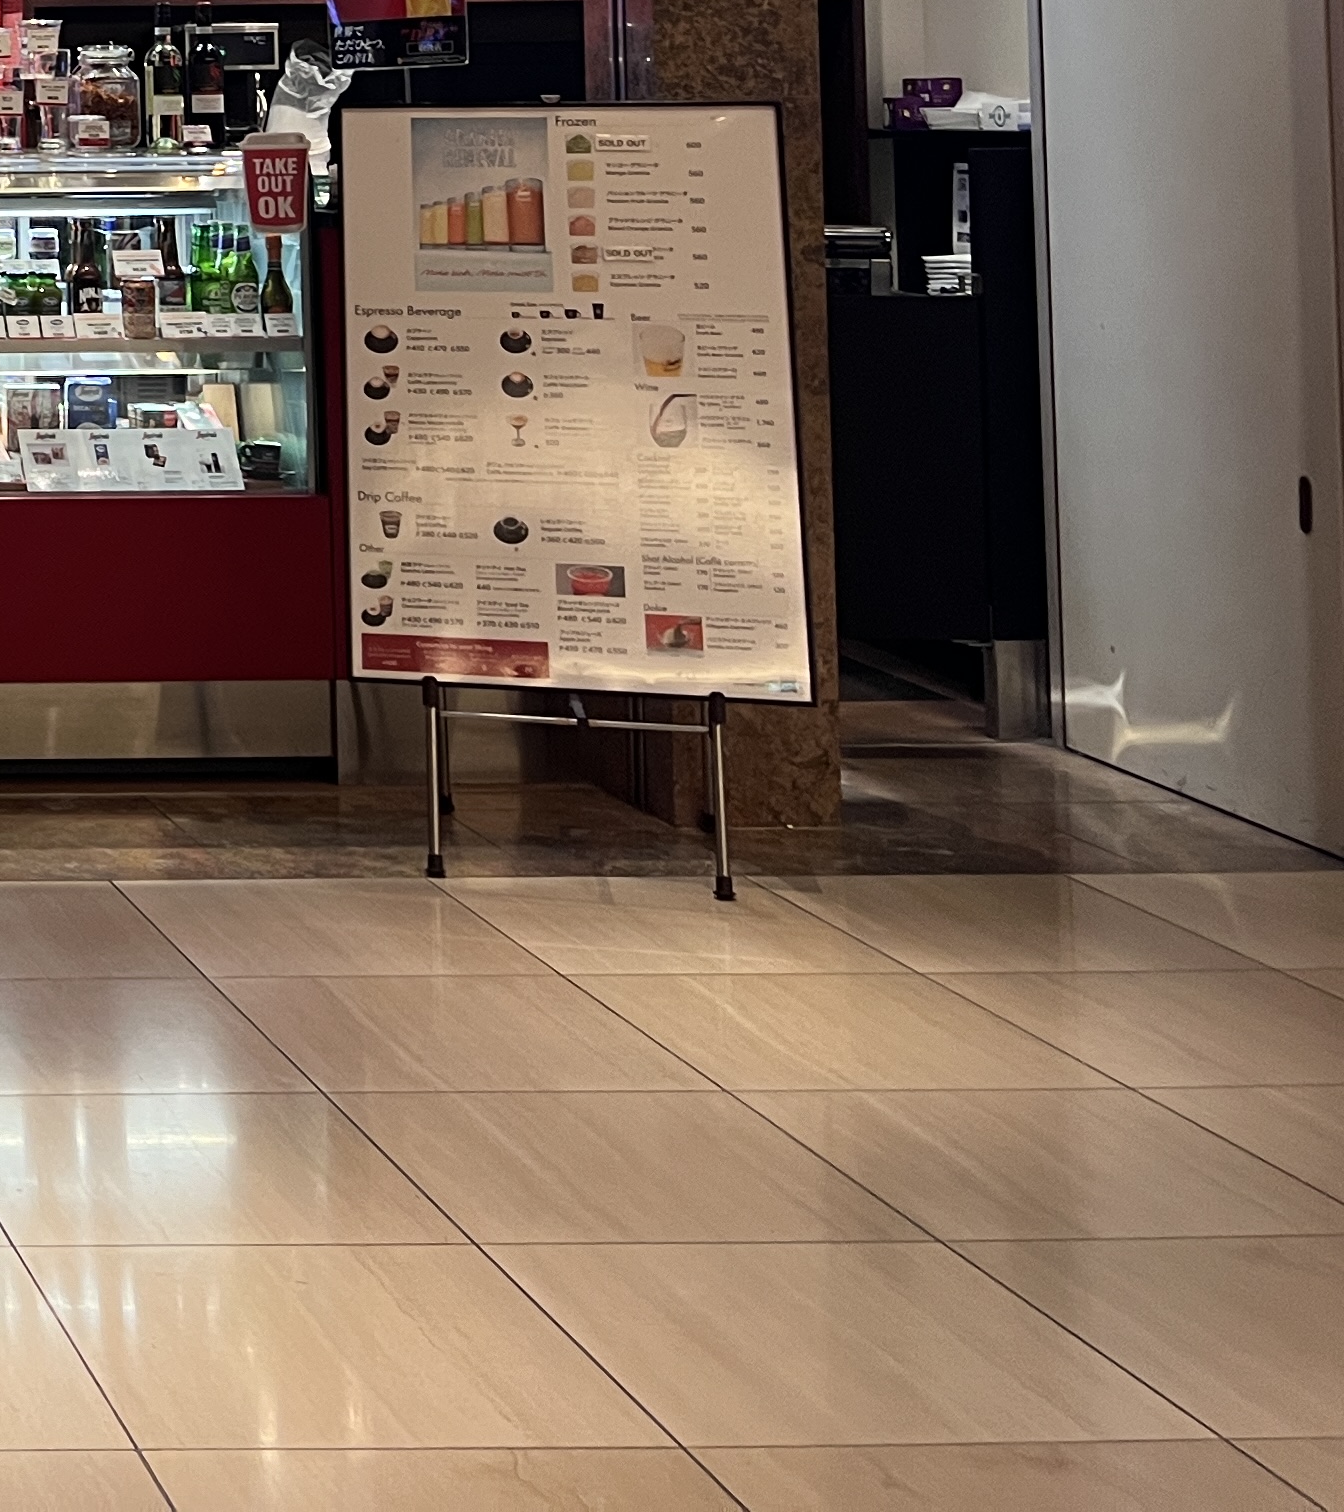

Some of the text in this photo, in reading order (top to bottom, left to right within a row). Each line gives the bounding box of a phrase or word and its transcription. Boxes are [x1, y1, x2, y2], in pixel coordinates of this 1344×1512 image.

[555, 116, 597, 127] Frozen
[598, 140, 646, 148] SOLD OUT
[252, 157, 298, 175] TAKE
[257, 175, 294, 193] OUT
[258, 196, 296, 219] OK
[605, 249, 653, 258] SOLD OUT
[354, 304, 462, 318] Espresso Beverage
[357, 491, 423, 504] Drip Coffee
[359, 544, 385, 553] Other
